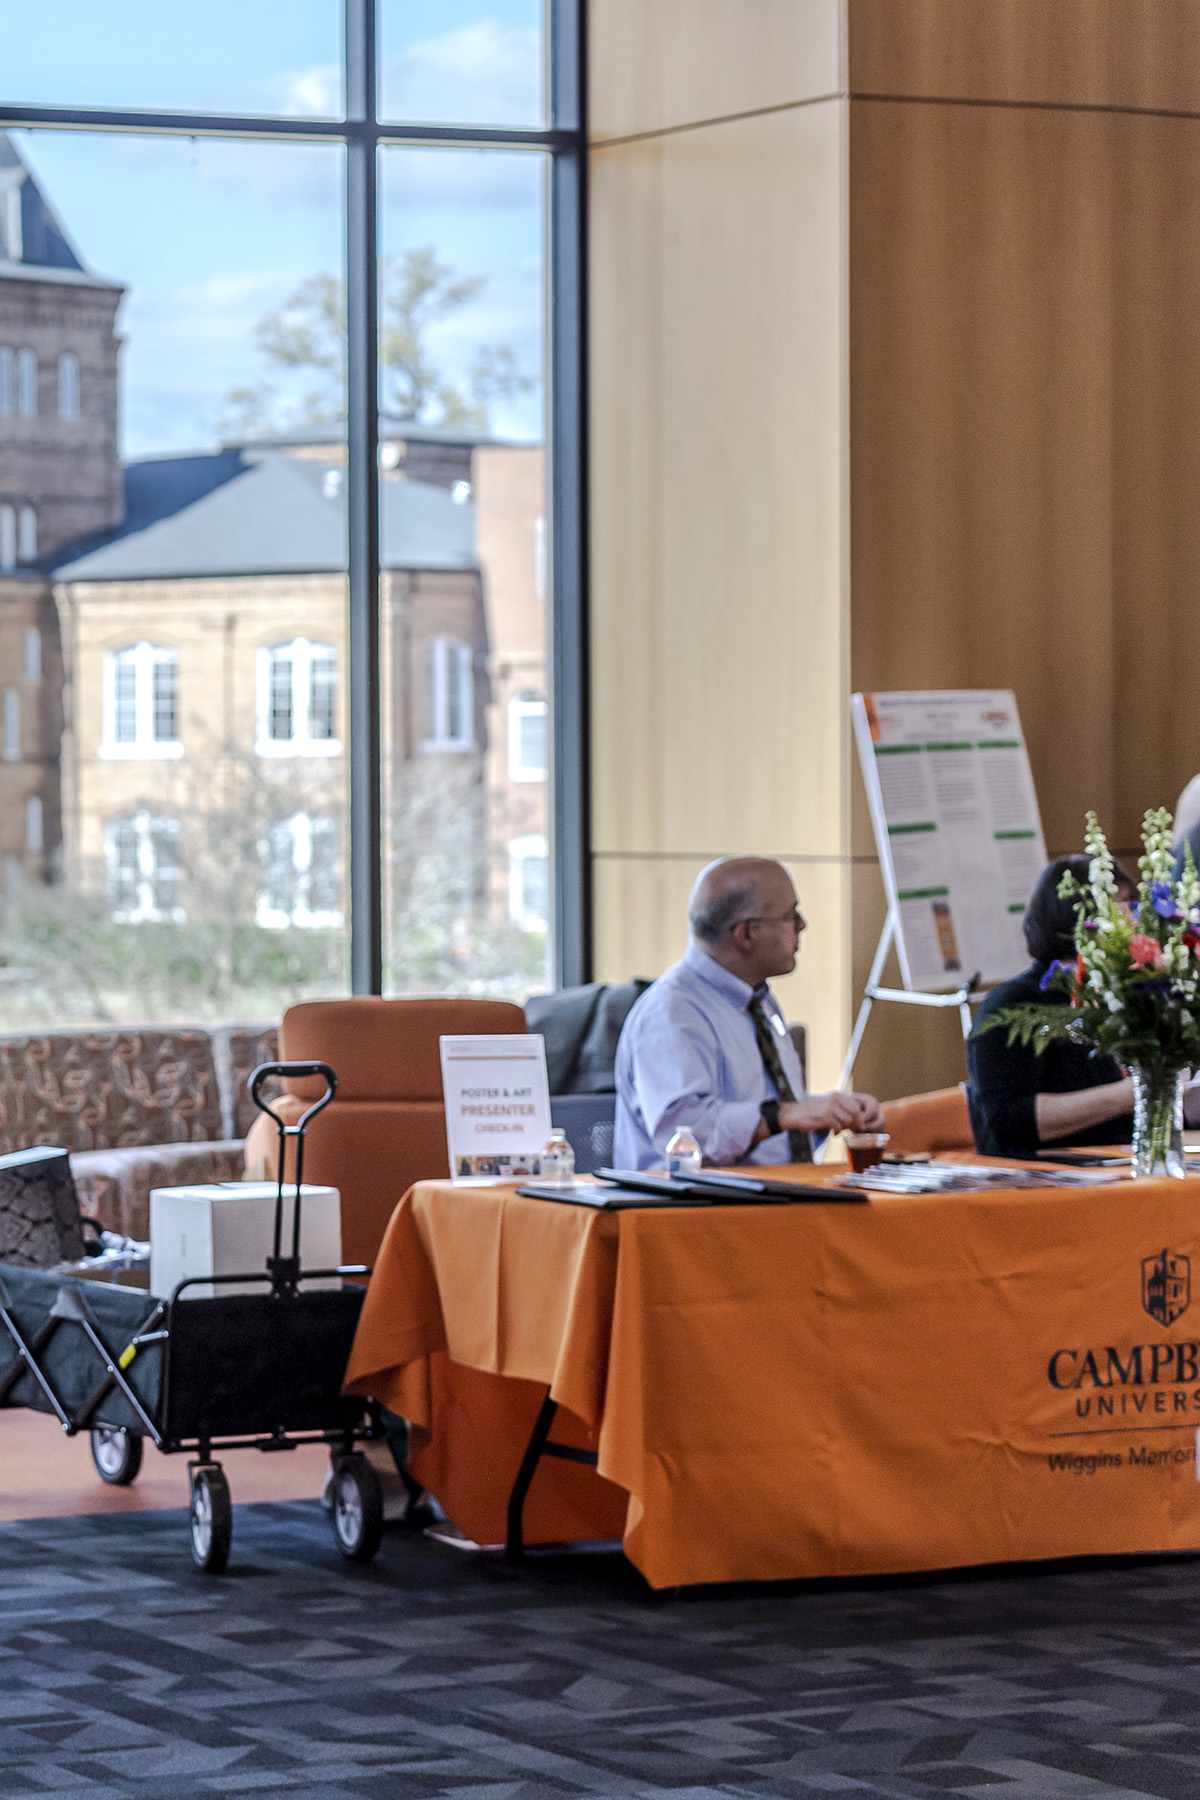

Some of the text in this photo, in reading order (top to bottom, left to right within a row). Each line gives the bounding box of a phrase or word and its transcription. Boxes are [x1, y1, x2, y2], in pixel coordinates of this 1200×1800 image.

[460, 1087, 500, 1098] POSTER
[513, 1087, 532, 1097] ART
[460, 1104, 536, 1117] PRESENTER
[1047, 1342, 1200, 1389] CAMPB
[1048, 1450, 1122, 1476] Wiggins
